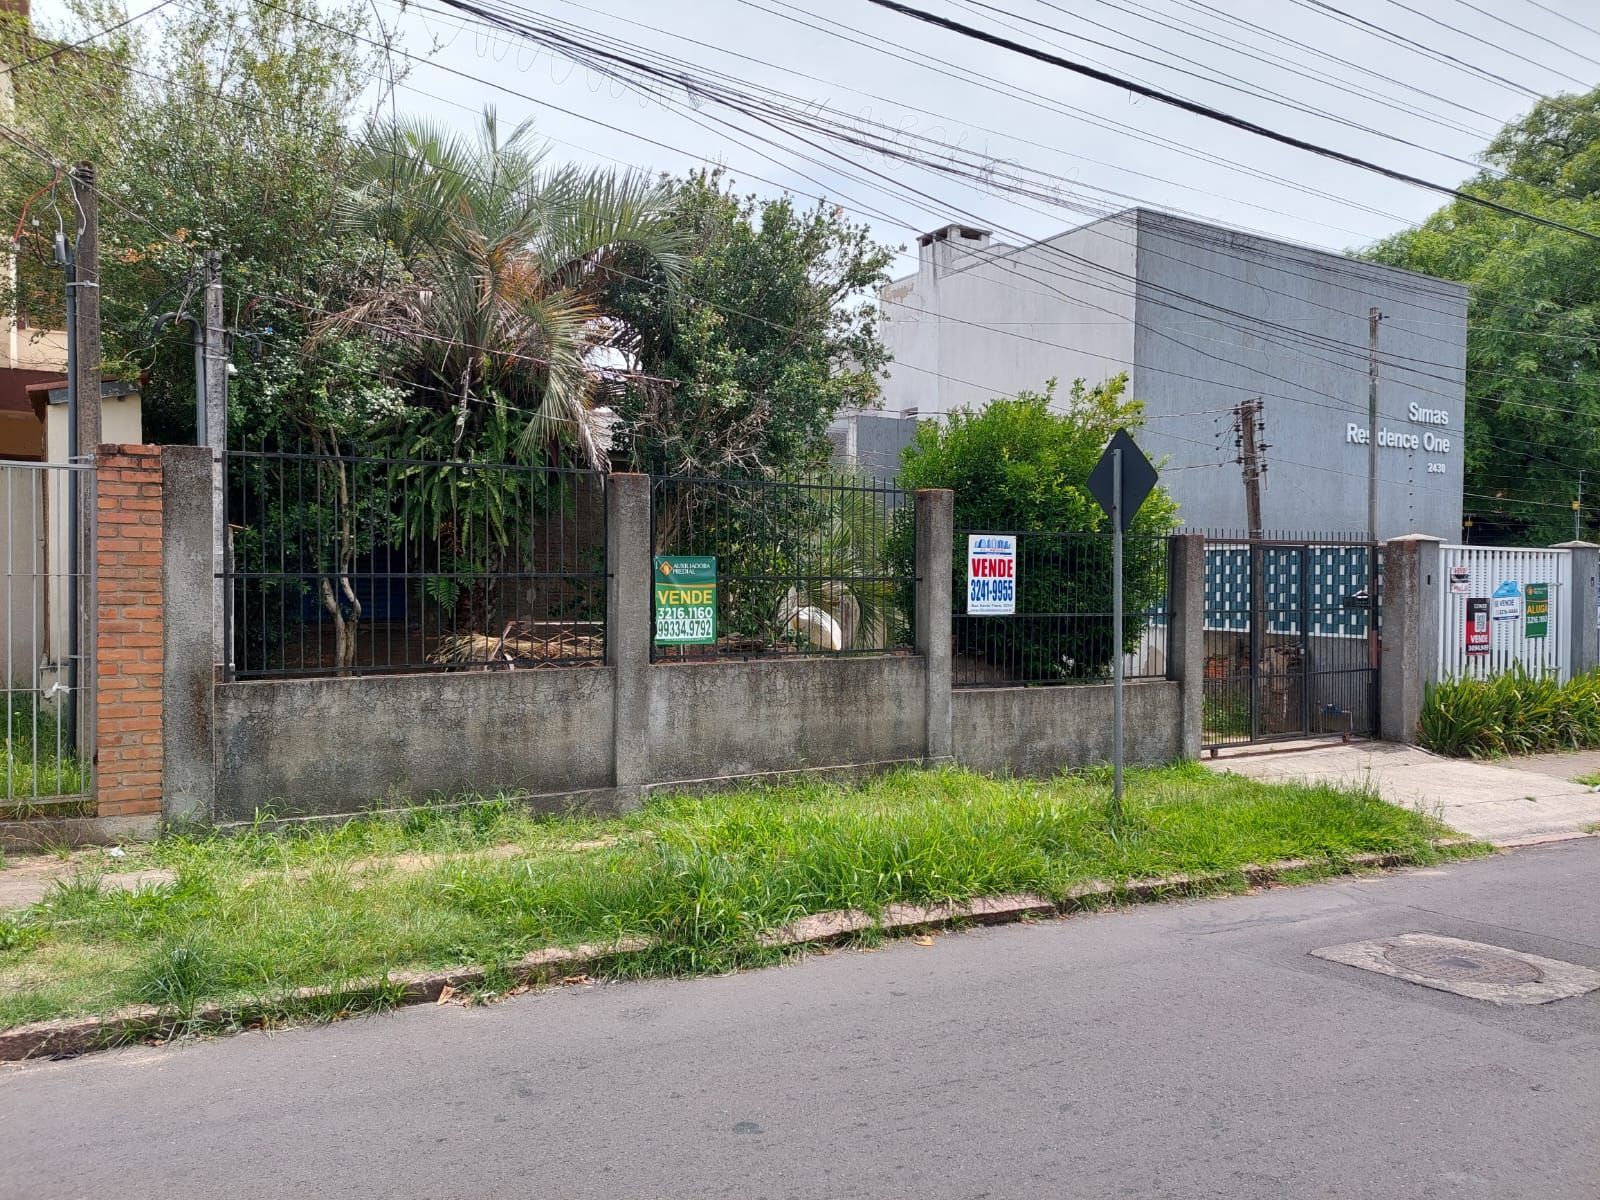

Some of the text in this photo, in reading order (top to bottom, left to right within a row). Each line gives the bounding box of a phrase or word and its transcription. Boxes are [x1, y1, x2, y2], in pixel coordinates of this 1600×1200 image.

[1409, 402, 1449, 425] Simas
[1347, 422, 1450, 453] Redence One
[1427, 463, 1446, 473] 2430
[971, 558, 1013, 577] VENDE
[657, 590, 713, 605] VENDE
[970, 579, 1013, 601] 3241-9955
[657, 607, 713, 619] 3216.1160
[657, 620, 712, 637] 99334.9792
